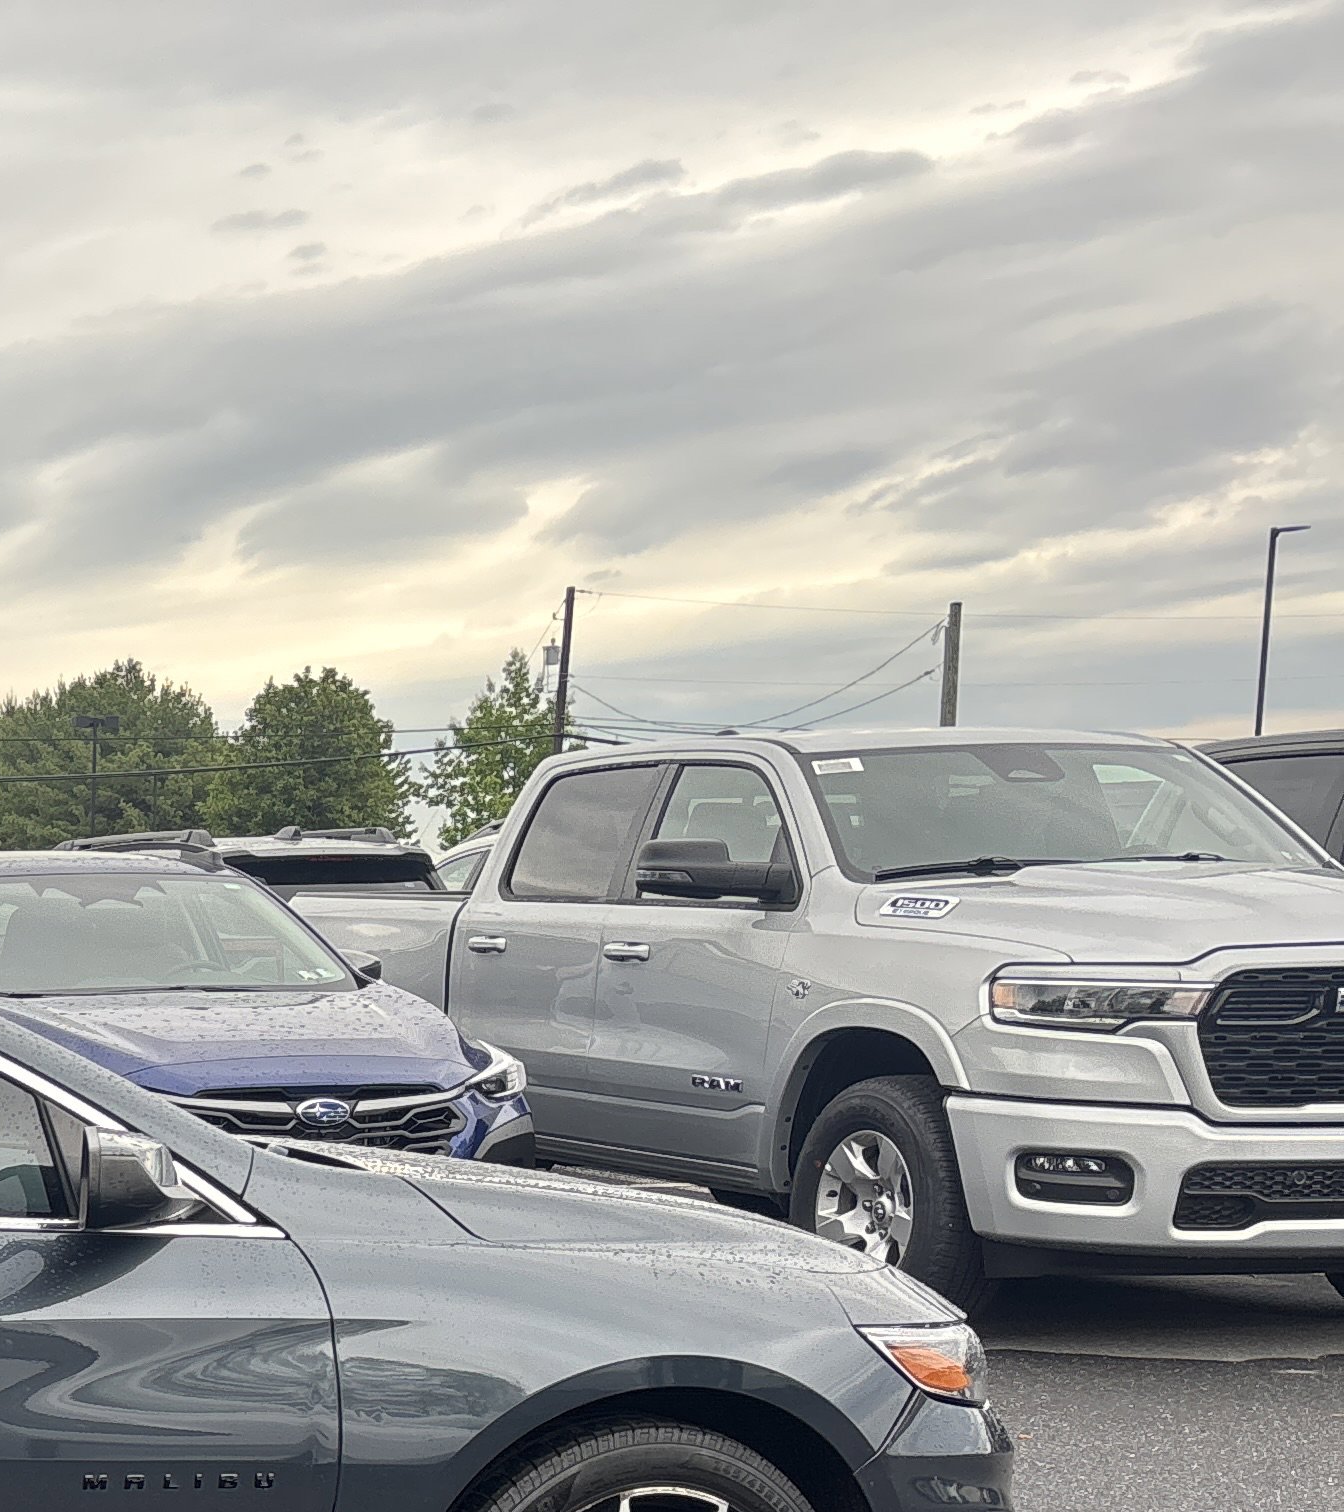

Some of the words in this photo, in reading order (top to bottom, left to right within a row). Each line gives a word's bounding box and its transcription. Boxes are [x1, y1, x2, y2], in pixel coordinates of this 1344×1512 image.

[895, 898, 946, 909] 1500
[691, 1073, 743, 1093] RAM
[81, 1472, 275, 1490] MALIBU
